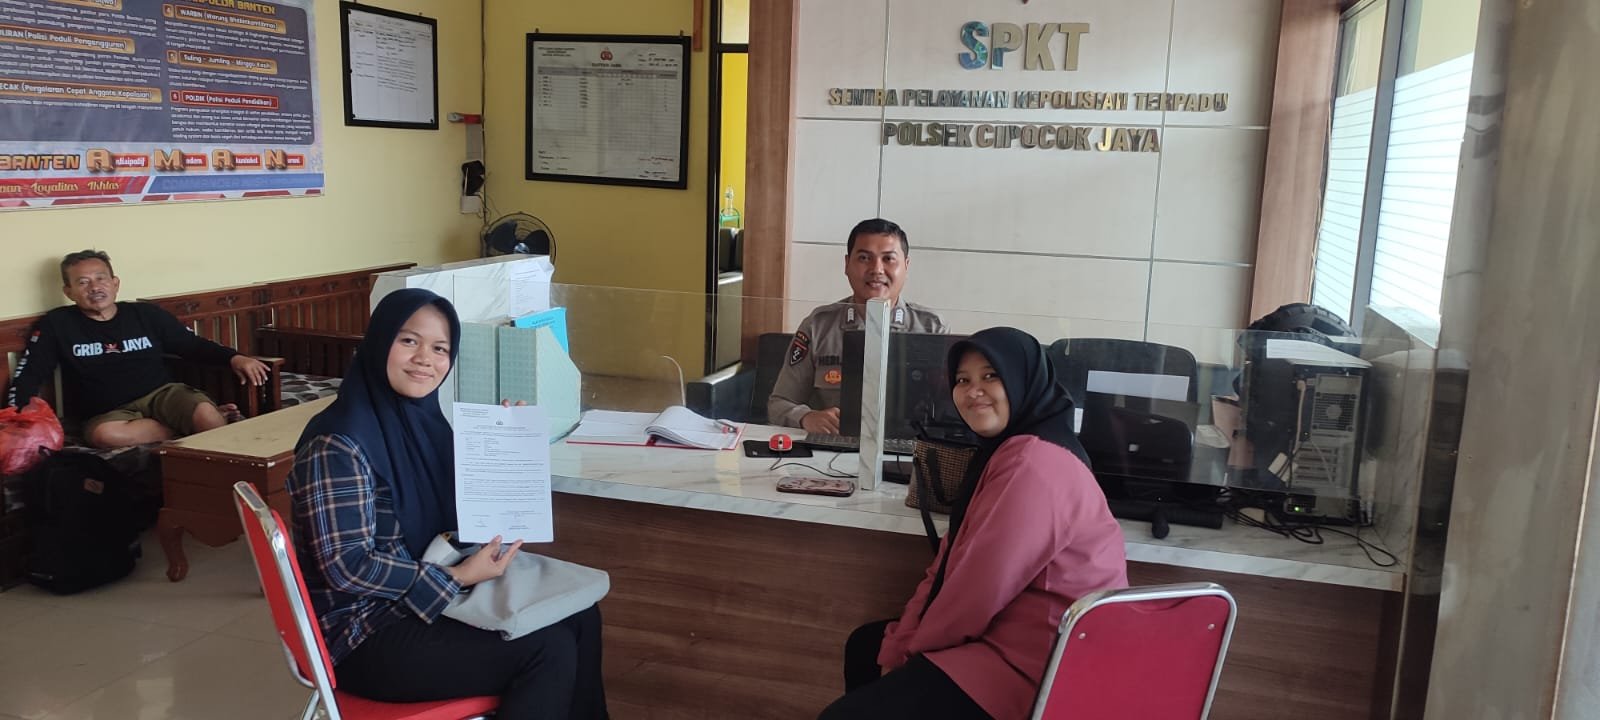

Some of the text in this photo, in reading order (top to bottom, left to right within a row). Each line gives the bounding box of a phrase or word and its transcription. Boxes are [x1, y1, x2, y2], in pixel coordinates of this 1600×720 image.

[957, 21, 1091, 71] SPKT
[829, 88, 1229, 113] SENTRA PELAYANAN KEPOLISIAN TERPADU
[883, 122, 1161, 152] POLSEK CIPOCOK JAYA
[0, 154, 80, 171] BANTEN
[31, 182, 79, 196] Loyalitas
[72, 336, 153, 357] GRIB JAYA
